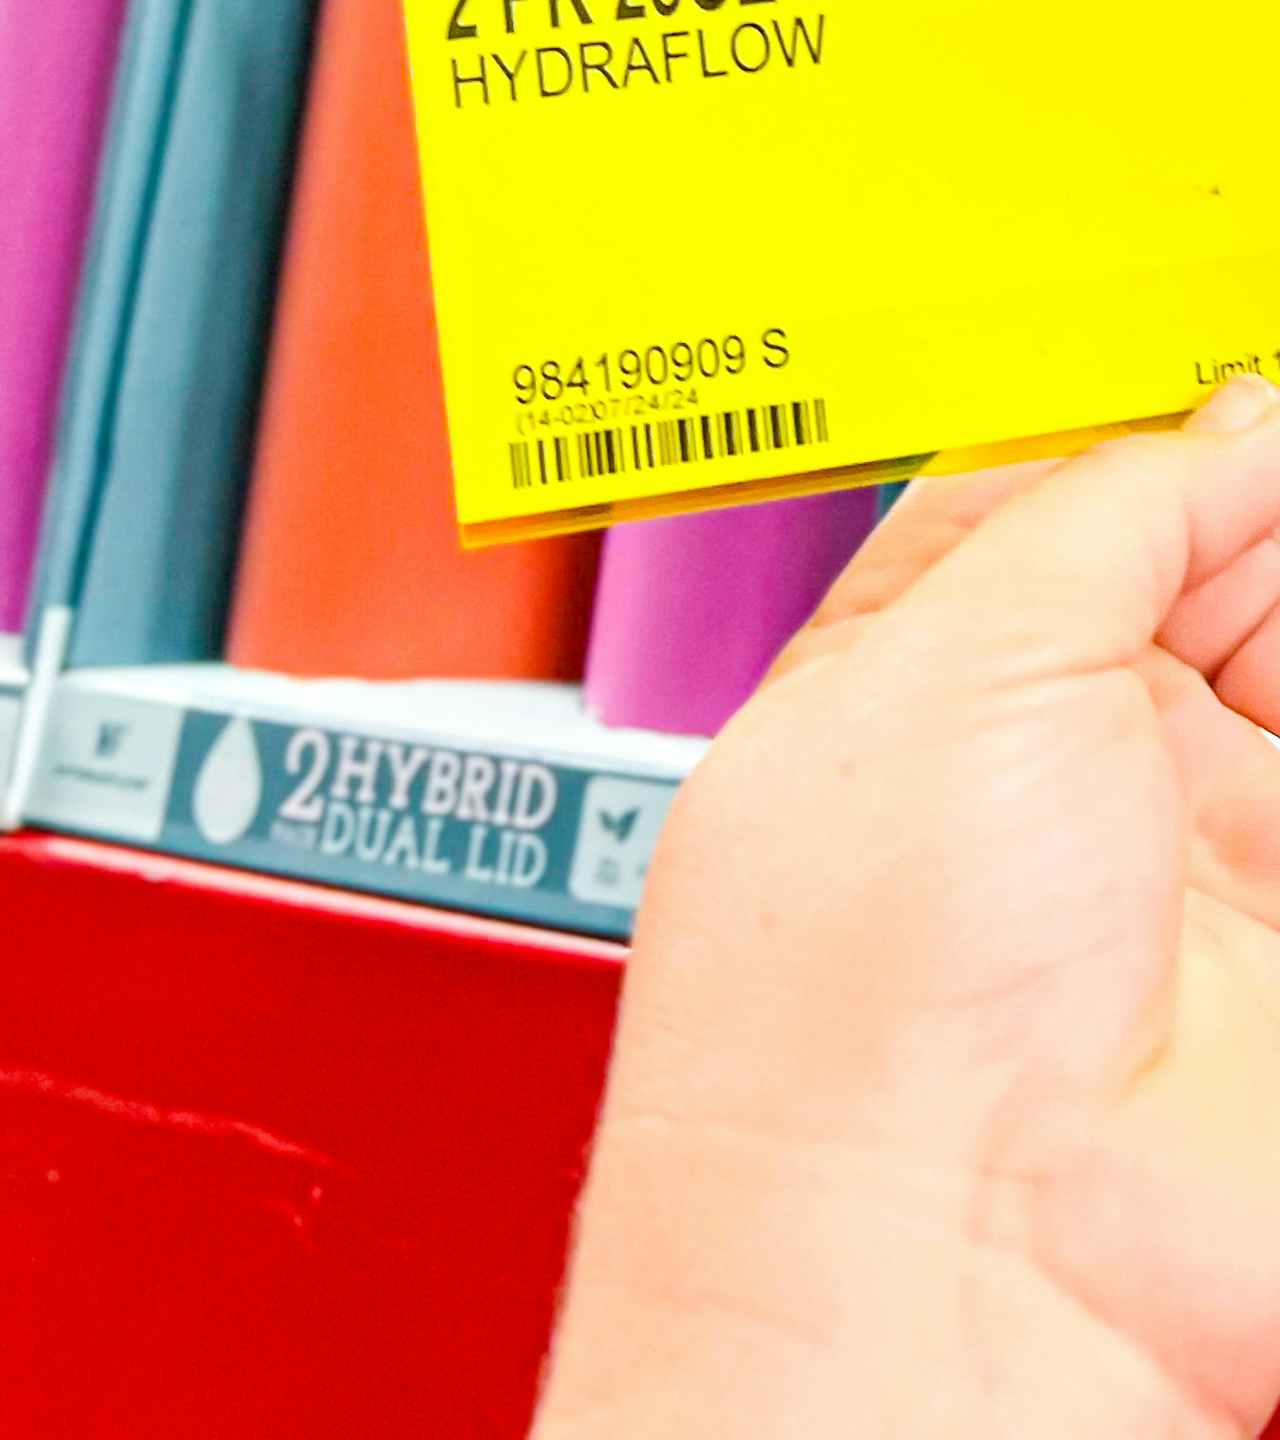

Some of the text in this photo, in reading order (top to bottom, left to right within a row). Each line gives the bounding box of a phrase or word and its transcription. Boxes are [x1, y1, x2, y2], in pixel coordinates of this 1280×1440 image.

[451, 14, 825, 108] HYDRAFLOW
[511, 327, 791, 405] 984190909 S
[1194, 354, 1264, 386] Limit
[278, 728, 558, 830] 2 HYBRID
[321, 800, 450, 876] DUAL
[465, 826, 548, 889] LID
